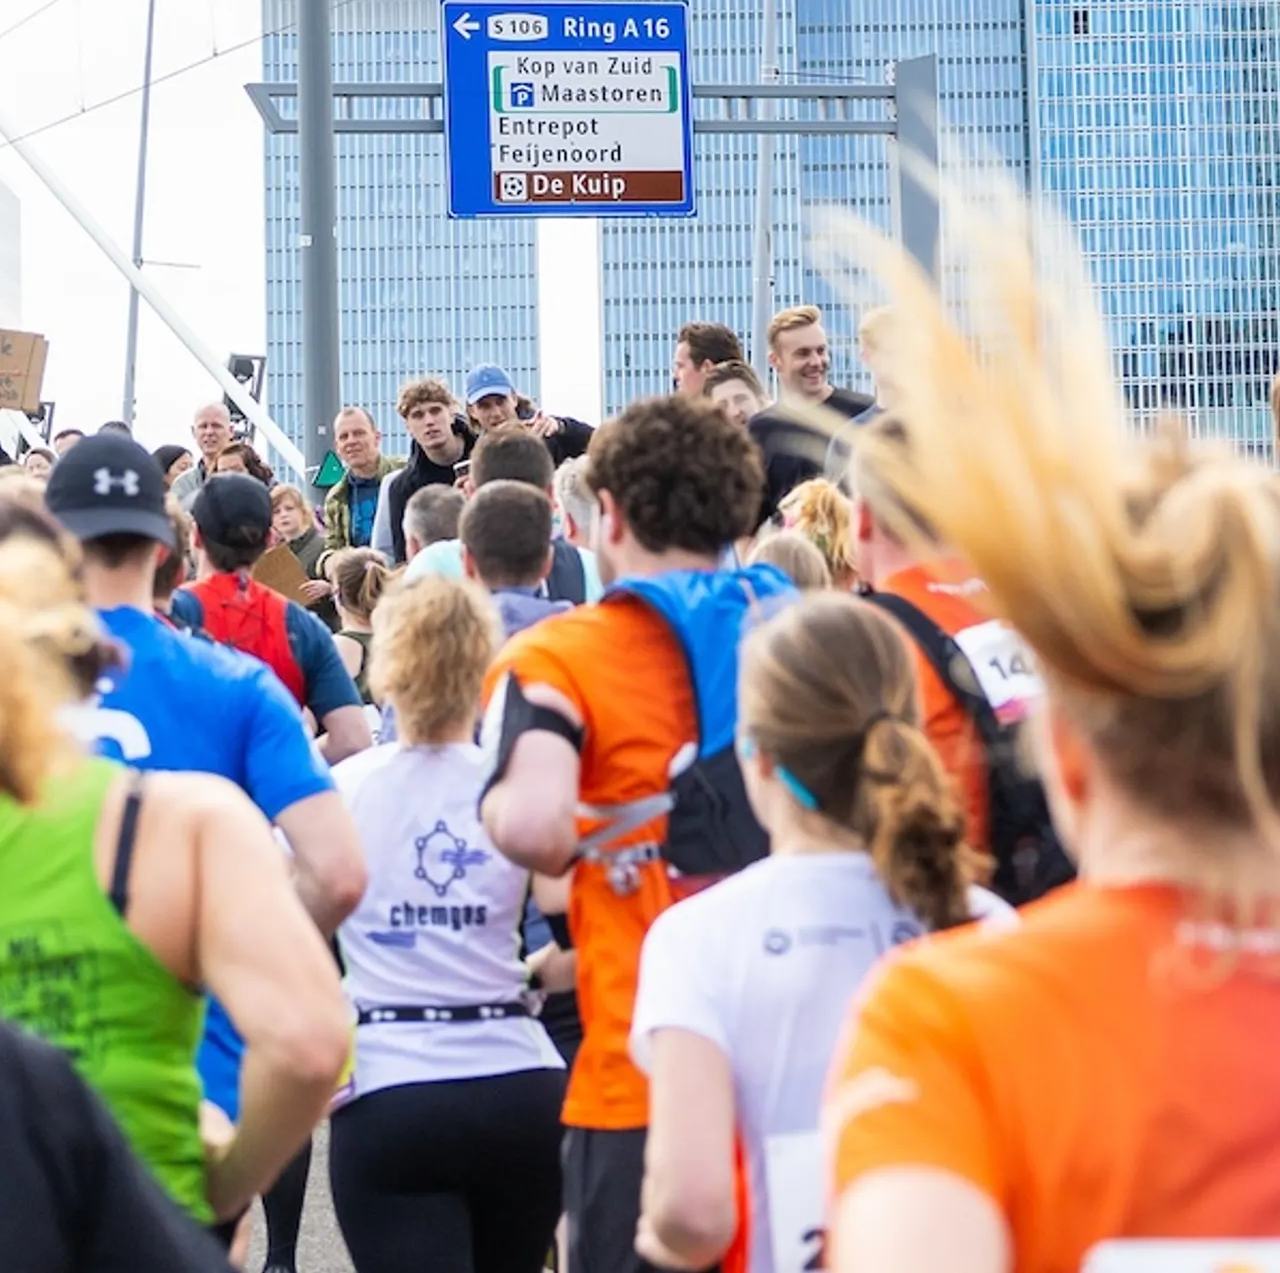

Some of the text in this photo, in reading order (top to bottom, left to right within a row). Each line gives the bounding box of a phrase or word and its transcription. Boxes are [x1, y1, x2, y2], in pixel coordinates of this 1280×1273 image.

[494, 19, 543, 34] S 106
[563, 17, 616, 43] Ring
[517, 57, 653, 81] Kop van Zuid
[541, 85, 663, 103] Maastoren
[498, 117, 599, 139] Entrepot
[498, 143, 622, 167] Feijenoord
[532, 174, 626, 198] De Kuip
